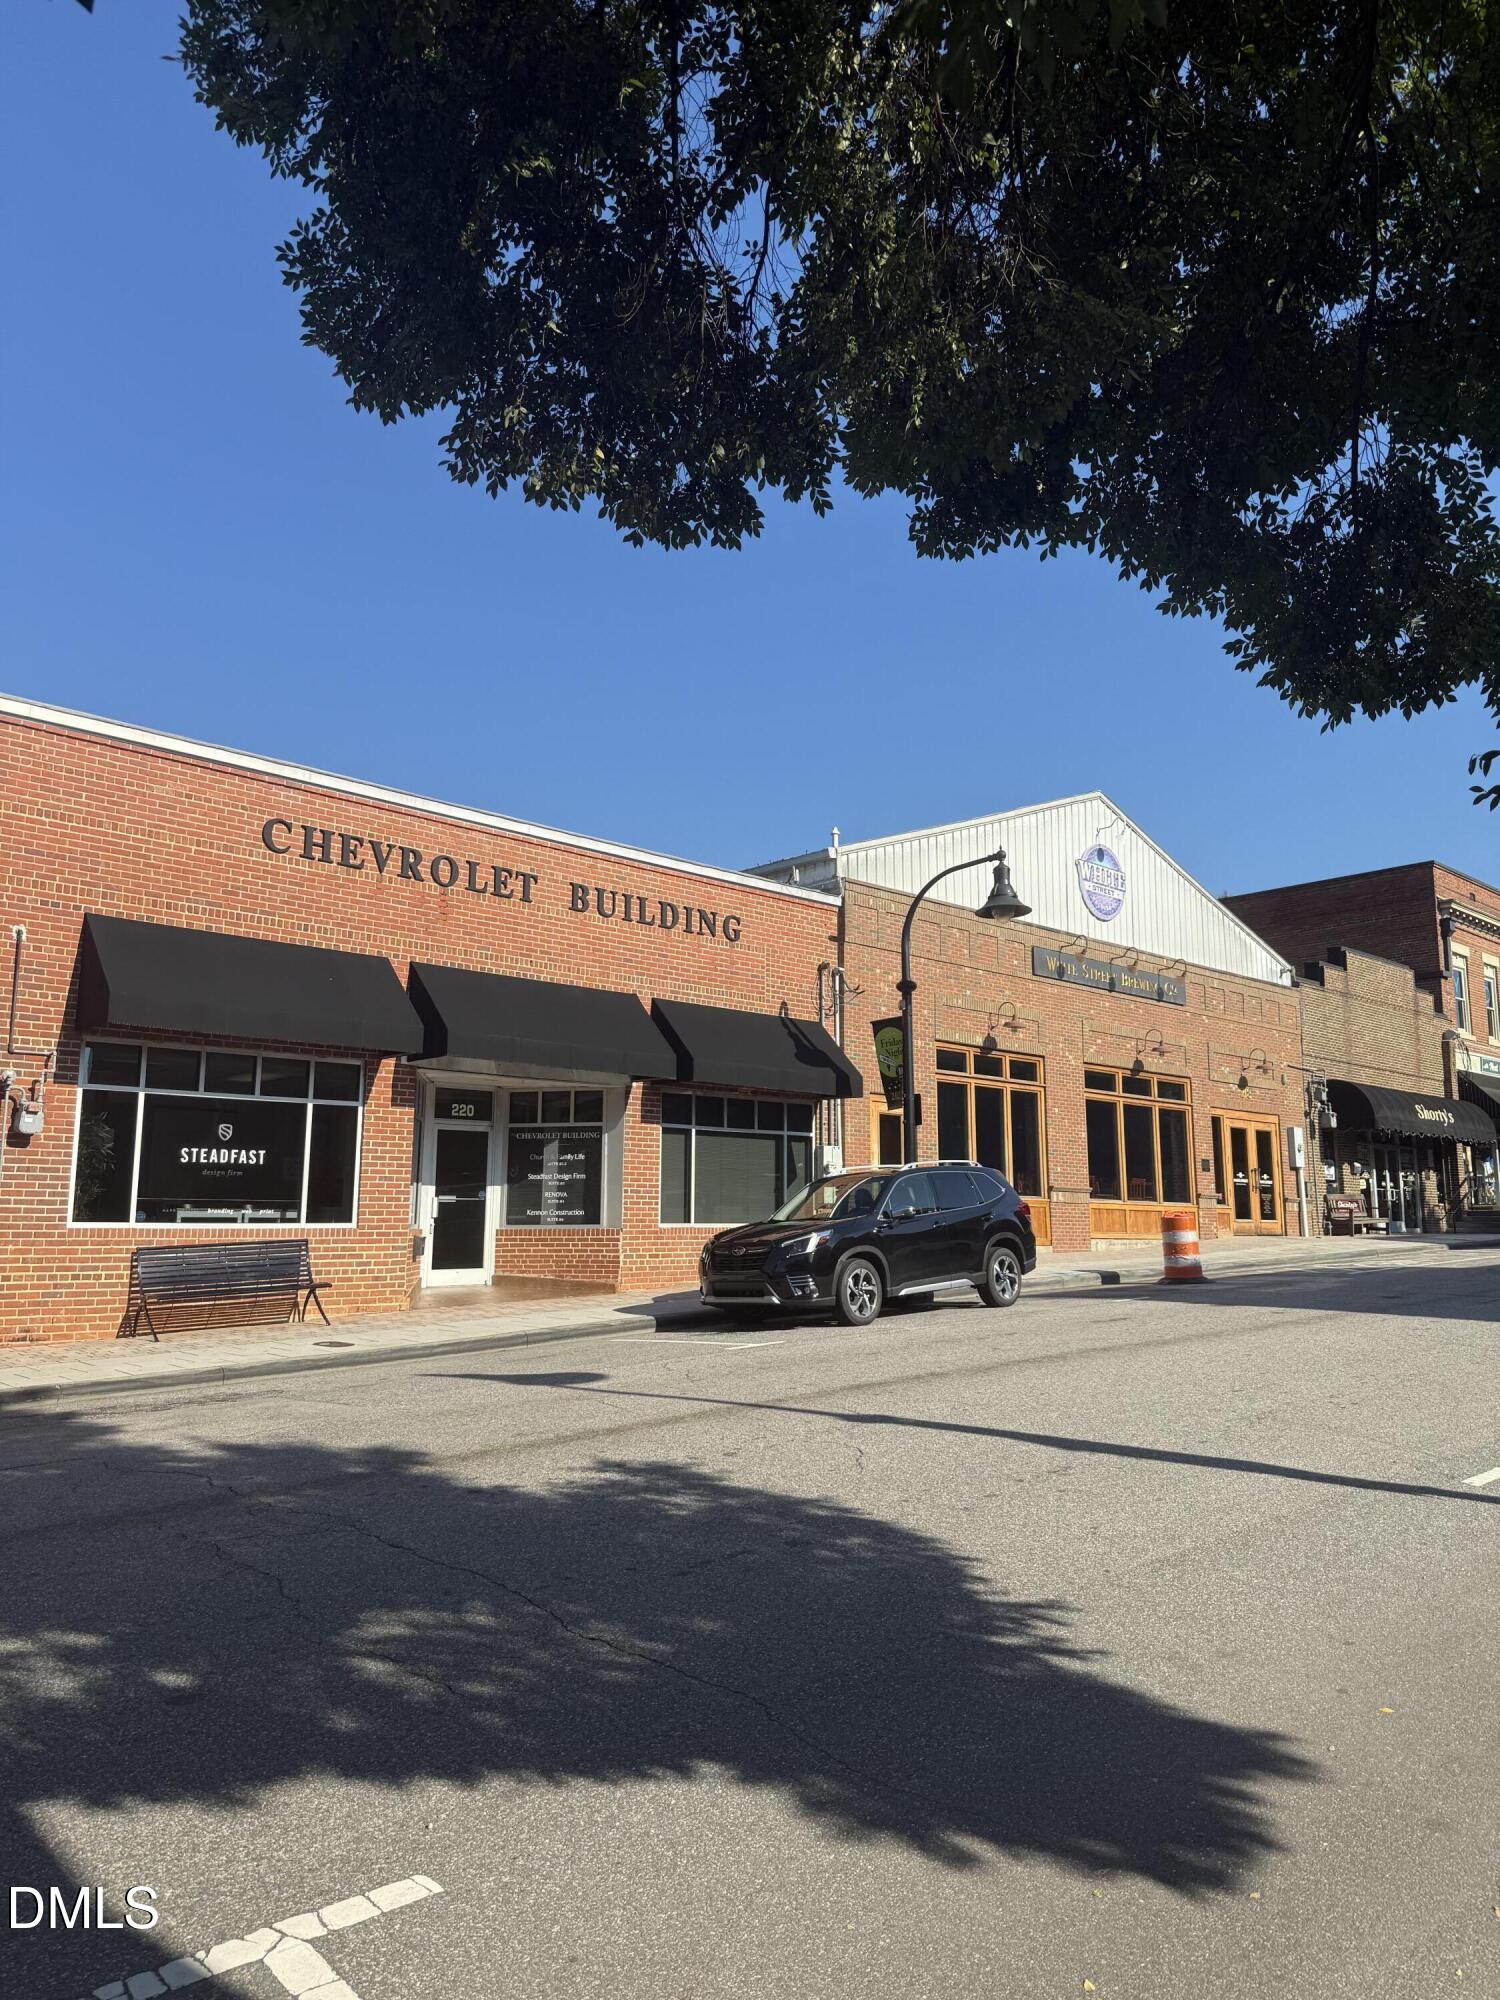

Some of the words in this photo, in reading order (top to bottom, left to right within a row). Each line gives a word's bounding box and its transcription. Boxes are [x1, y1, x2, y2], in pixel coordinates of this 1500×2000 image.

[262, 818, 538, 903] CHEVROLET
[569, 881, 742, 942] BUILDING
[1092, 884, 1115, 896] STREET
[885, 1047, 903, 1057] Nigh
[451, 1103, 475, 1117] 220
[1414, 1104, 1455, 1127] Shorty's
[516, 1132, 560, 1140] CHEVROLET
[562, 1131, 600, 1139] BUILDING
[180, 1147, 267, 1165] STEADFAST
[201, 1168, 225, 1177] design
[225, 1168, 244, 1177] firm
[553, 1173, 572, 1181] Design
[207, 1207, 234, 1215] branding
[549, 1208, 585, 1216] Construction
